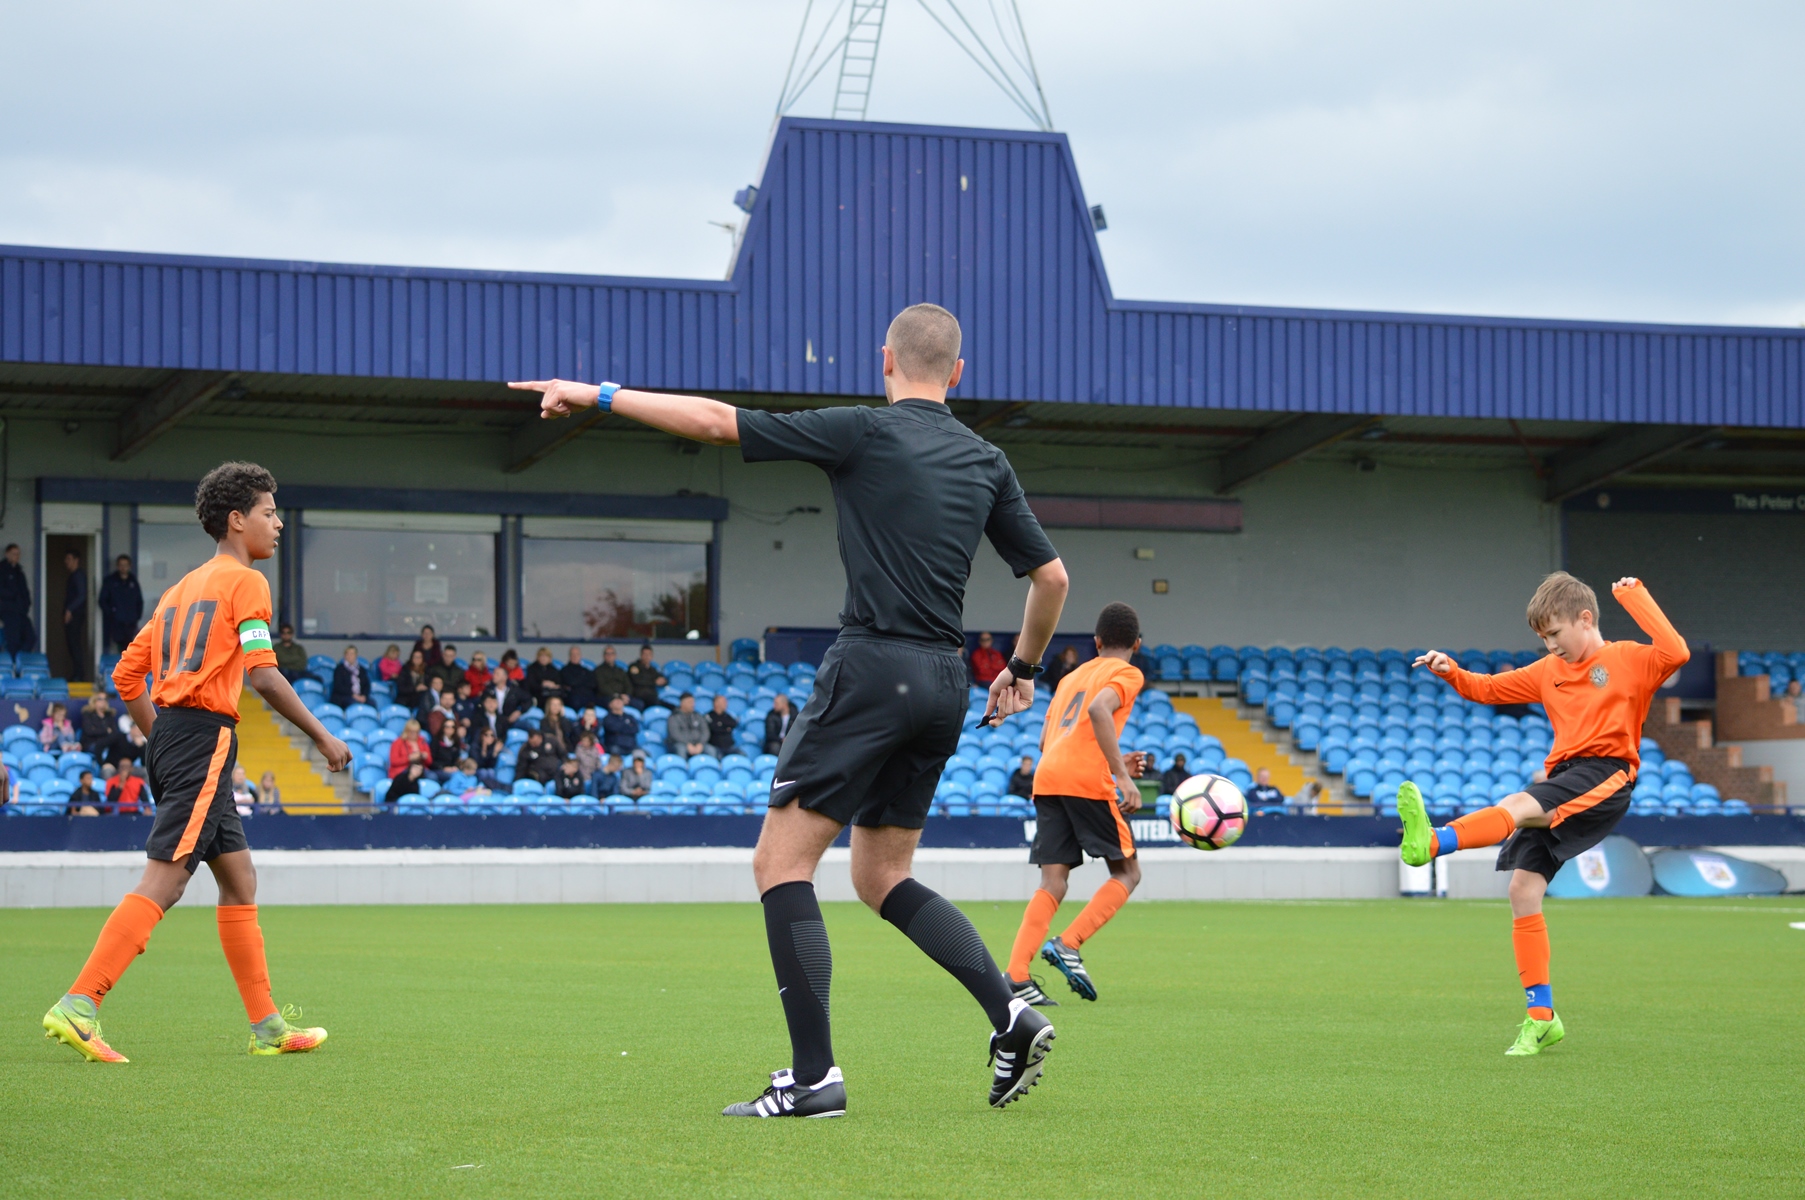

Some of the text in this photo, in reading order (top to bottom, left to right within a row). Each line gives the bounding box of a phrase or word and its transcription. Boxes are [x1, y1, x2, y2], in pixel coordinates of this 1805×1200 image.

[1732, 493, 1758, 510] The
[1759, 494, 1794, 511] Peter
[159, 599, 220, 681] 10
[252, 630, 269, 639] CAP
[1059, 690, 1086, 736] 4
